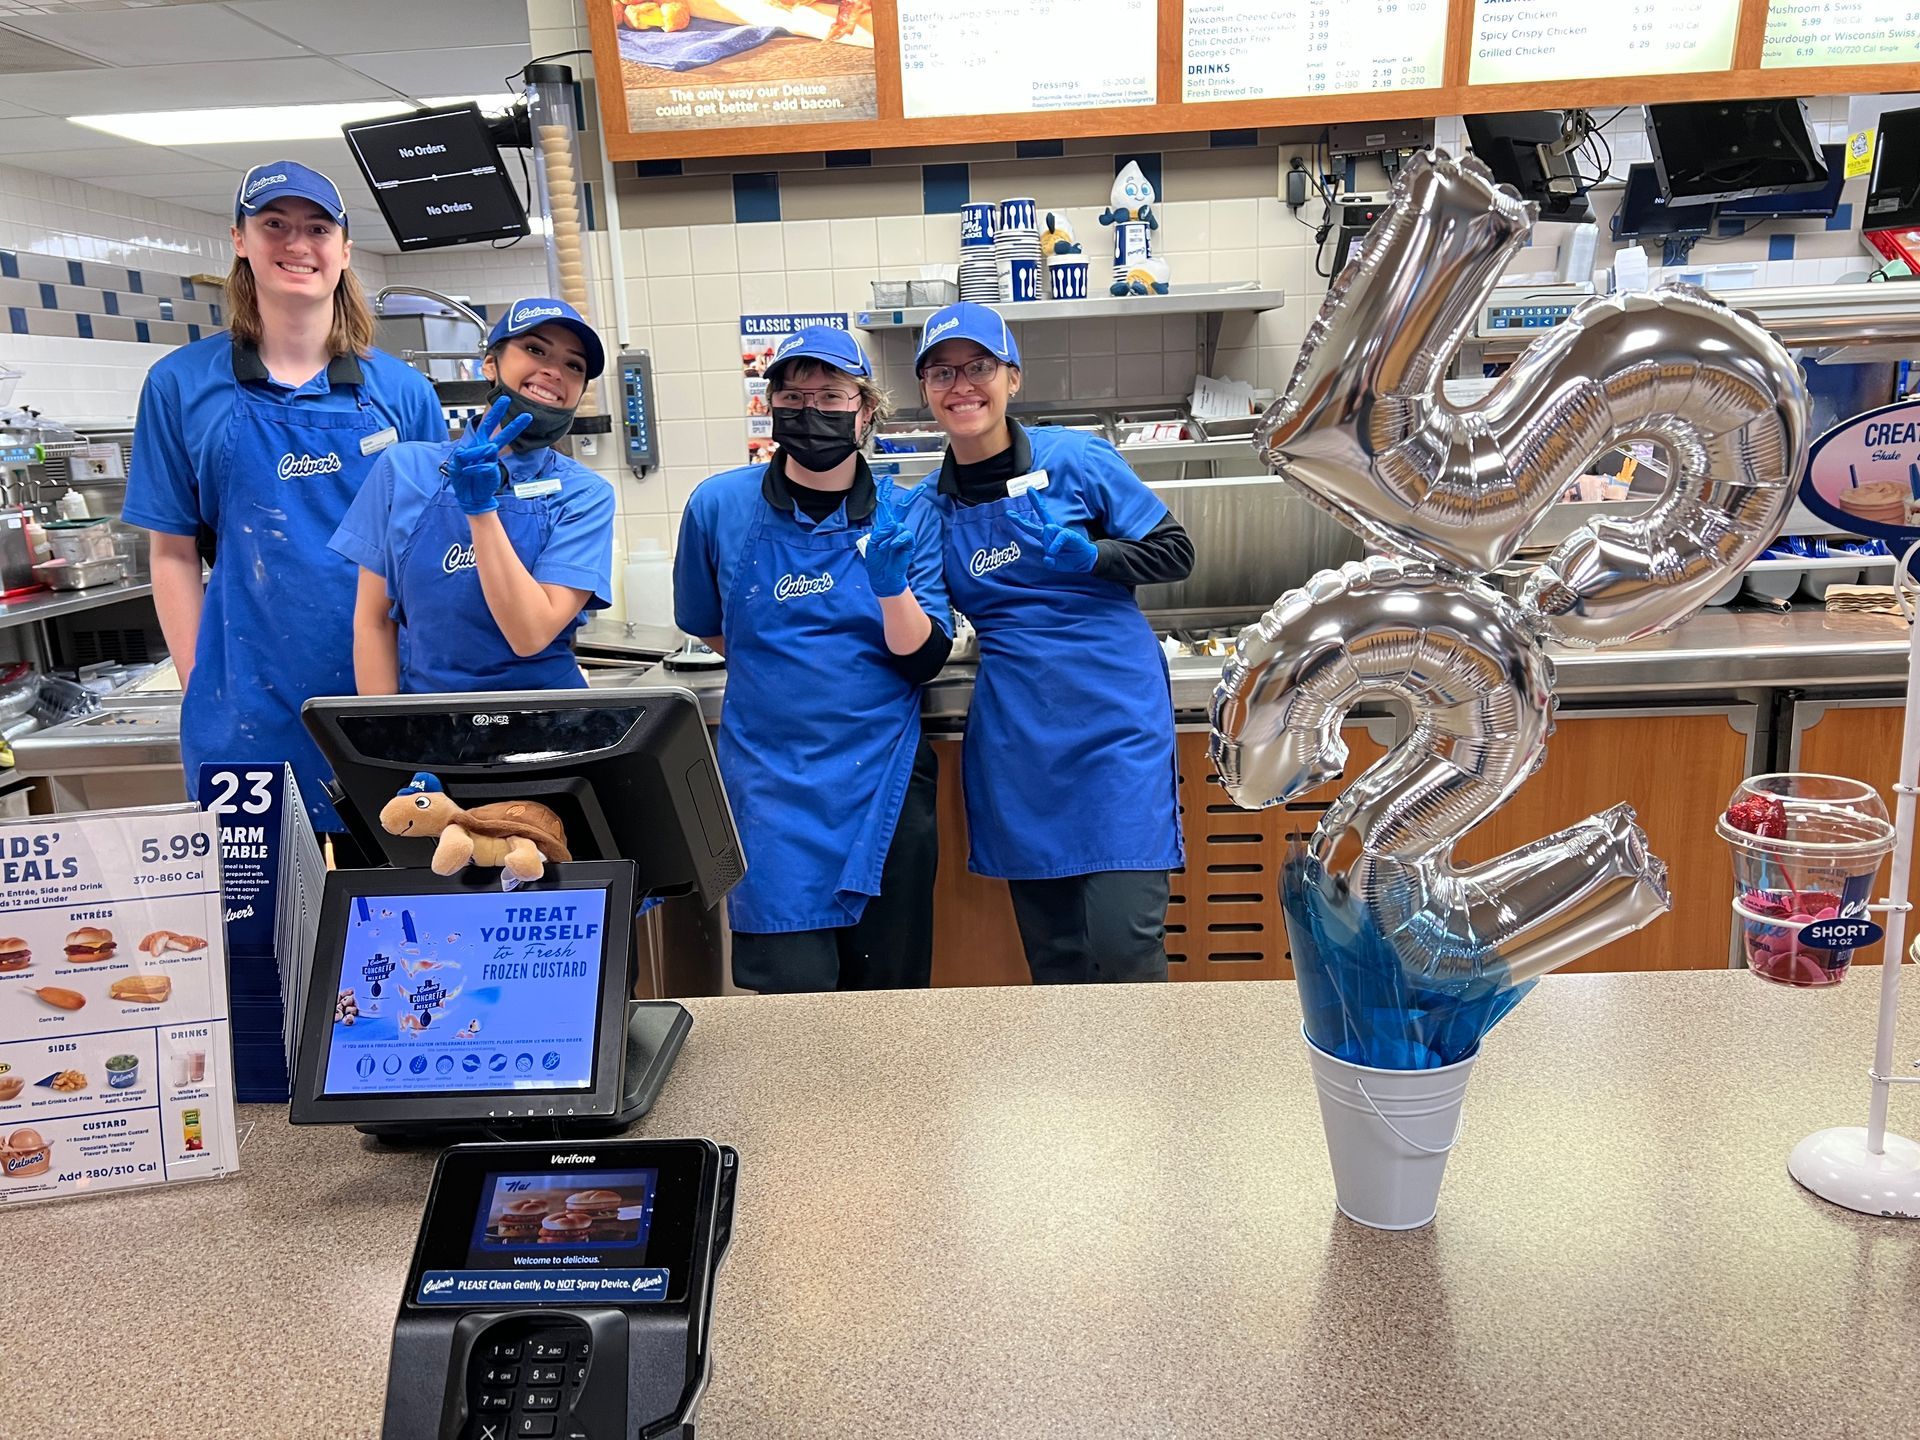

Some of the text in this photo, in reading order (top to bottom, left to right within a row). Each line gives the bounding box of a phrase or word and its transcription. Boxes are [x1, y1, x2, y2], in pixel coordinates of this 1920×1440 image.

[1769, 2, 1862, 14] Mushroom & Swiss
[1189, 11, 1296, 25] Wisconsin Cheese Curds
[1482, 10, 1558, 23] Crispy Chicken
[1802, 17, 1822, 26] 5.99
[1188, 26, 1218, 36] Pretzel
[1222, 25, 1242, 34] Bites
[1480, 26, 1587, 41] Spicy Crispy Chicken
[1763, 28, 1916, 44] Sourdough or Wisconsin Swiss
[1188, 36, 1247, 47] Chili Cheddar
[1188, 48, 1227, 58] George's
[1479, 45, 1555, 58] Grilled Chicken
[1796, 47, 1814, 56] 6.19
[1863, 44, 1876, 53] Cal
[1188, 63, 1231, 75] DRINKS
[1187, 78, 1205, 88] Soft
[1208, 77, 1235, 87] Drinks
[670, 84, 826, 102] The only way our Deluxe
[1187, 89, 1211, 98] Fresh
[1213, 87, 1246, 97] Brewed
[1249, 86, 1264, 95] Tea
[656, 97, 844, 117] could get better add bacon.
[399, 143, 447, 159] No Orders
[1654, 196, 1666, 204] No
[426, 201, 473, 216] No Orders
[745, 319, 791, 333] CLASSIC
[1872, 450, 1901, 462] Shake
[277, 452, 341, 480] Culver's
[774, 572, 834, 601] Culver's
[207, 771, 274, 815] 23
[218, 827, 264, 843] ARM
[141, 832, 210, 863] 5.99
[222, 845, 268, 859] TABLE
[133, 872, 182, 885] 370-860
[186, 870, 204, 881] Cal
[7, 882, 103, 899] Entrée, Side and Drink
[23, 897, 40, 905] and
[42, 895, 68, 904] Under
[70, 909, 113, 921] ENTRÉES
[225, 904, 254, 922] lver's
[505, 906, 577, 924] TREAT
[480, 924, 598, 942] YOURSELF
[1811, 925, 1869, 938] SHORT
[494, 941, 576, 961] to Fresh
[364, 963, 392, 974] CONCRETE
[483, 961, 587, 980] FROZEN CUSTARD
[412, 990, 443, 1003] CONCRETE
[48, 1028, 208, 1053] SIDES DRINKS
[83, 1119, 127, 1131] CUSTARD
[128, 1128, 149, 1136] Custard
[8, 1152, 44, 1171] Culver's
[550, 1154, 596, 1164] Verifone
[58, 1161, 157, 1182] Add 280/310 Cal
[513, 1255, 600, 1265] Welcome to delicious.
[458, 1280, 488, 1290] PLEASE
[489, 1280, 512, 1290] Clean
[513, 1279, 541, 1291] Gently,
[543, 1280, 555, 1289] Do
[557, 1279, 576, 1289] NOT
[576, 1278, 600, 1291] Spray
[601, 1278, 630, 1289] Device.
[494, 1344, 588, 1355] 1 2 ABC 3
[488, 1371, 494, 1380] 4
[533, 1370, 539, 1380] 5
[483, 1396, 489, 1405] 7
[528, 1395, 535, 1405] 8
[524, 1420, 531, 1430] 0
